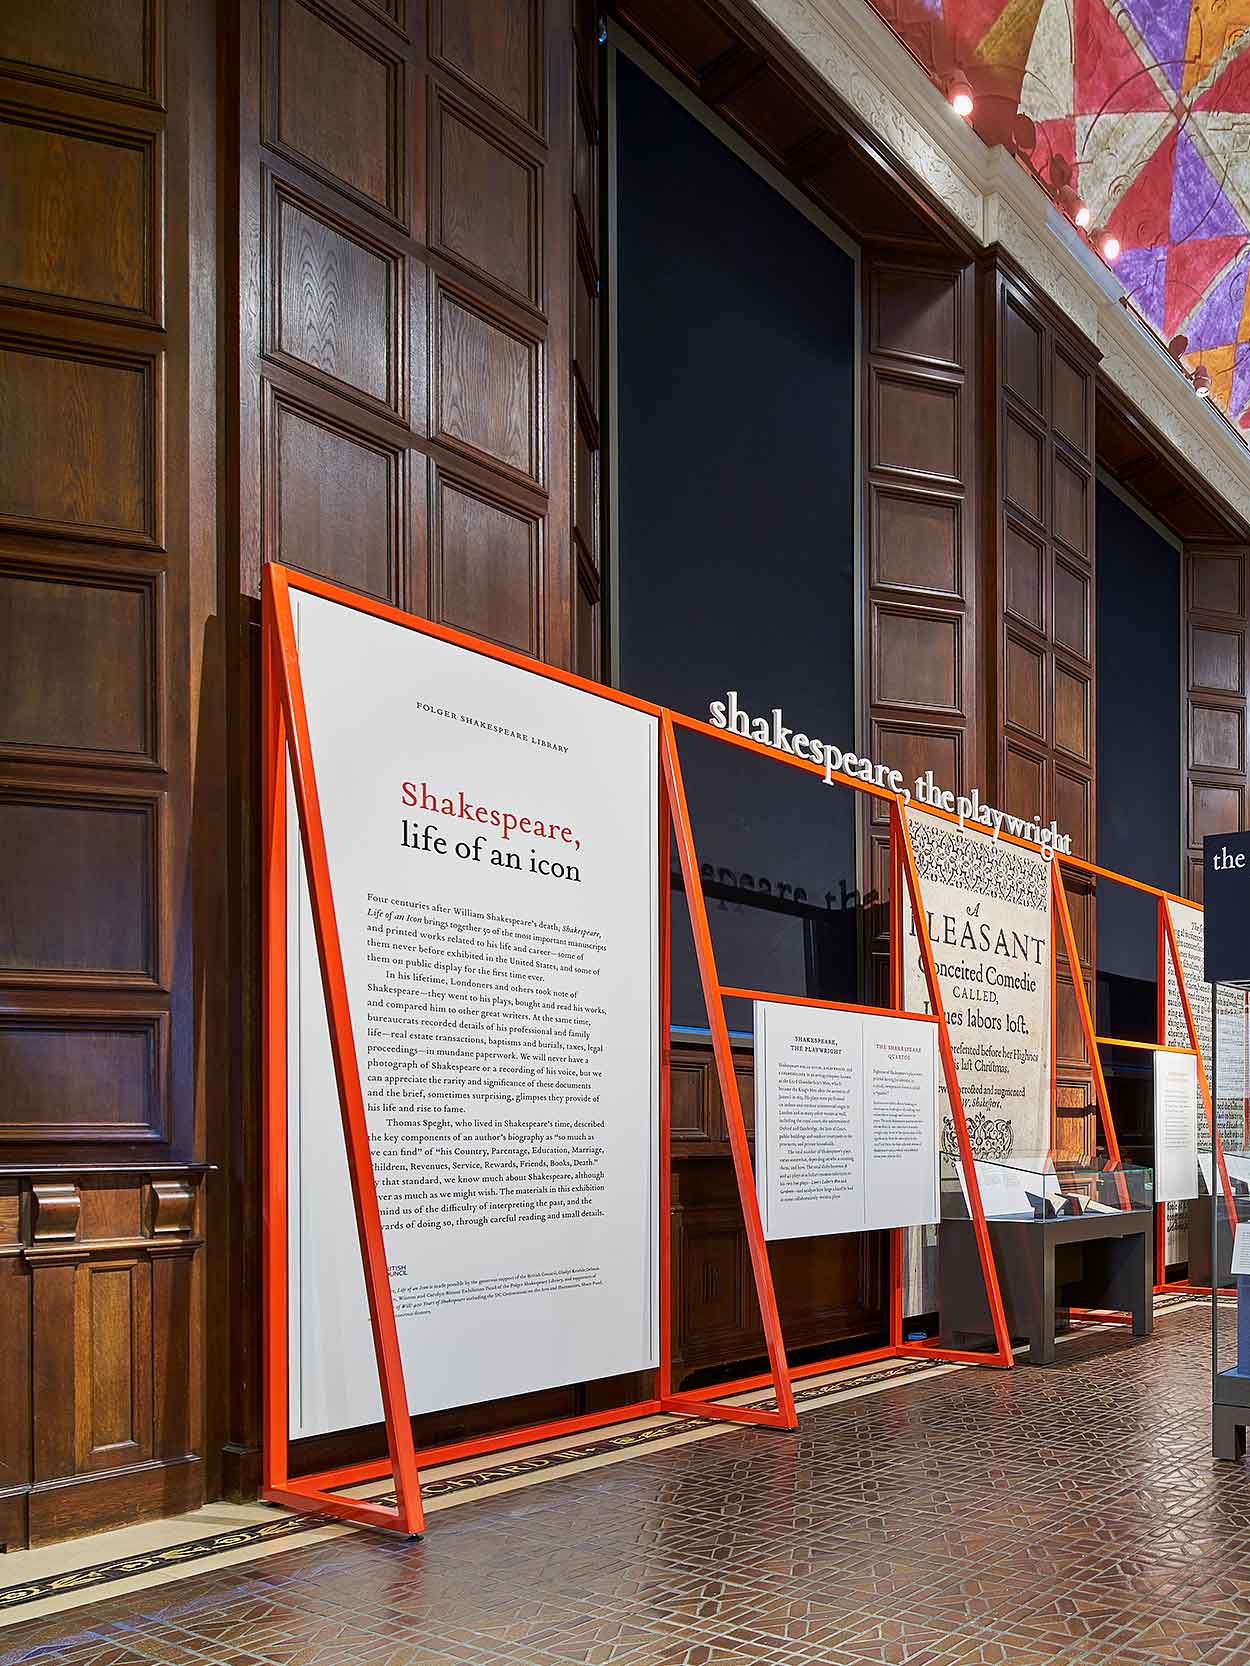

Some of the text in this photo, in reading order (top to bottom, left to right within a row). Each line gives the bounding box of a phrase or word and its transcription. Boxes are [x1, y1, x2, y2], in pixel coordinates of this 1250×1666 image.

[416, 702, 569, 754] FOLGER SHAKESPEARE LIBRARY
[709, 691, 1072, 862] shakespeare, the playwright
[402, 782, 580, 851] Shakespeare,
[401, 820, 581, 882] life of an icon
[1213, 847, 1246, 870] the
[367, 893, 388, 903] Four
[390, 898, 430, 910] centuries
[431, 903, 451, 914] after
[453, 907, 484, 919] William
[967, 902, 980, 917] A
[366, 924, 383, 932] and
[385, 926, 417, 937] printed
[419, 932, 445, 941] works
[447, 935, 475, 945] related
[486, 939, 498, 948] his
[499, 941, 511, 951] life
[367, 908, 383, 919] Life
[384, 911, 392, 921] of
[406, 914, 422, 923] Icon
[423, 916, 448, 930] brings
[450, 922, 482, 933] together
[501, 928, 513, 937] the
[532, 933, 566, 945] important
[567, 941, 606, 952] manuscripts
[367, 937, 390, 948] them
[392, 943, 416, 951] never
[418, 944, 444, 955] before
[446, 949, 484, 960] exhibited
[485, 953, 494, 962] in
[495, 955, 508, 964] the
[509, 957, 534, 967] United
[367, 952, 390, 963] them
[405, 958, 431, 968] public
[433, 960, 462, 974] display
[464, 965, 476, 973] for
[478, 966, 490, 975] the
[492, 967, 508, 977] first
[509, 970, 526, 979] time
[385, 970, 395, 979] In
[398, 971, 410, 980] his
[450, 977, 493, 989] Londoners
[494, 983, 509, 991] and
[510, 984, 534, 993] others
[535, 988, 551, 996] took
[986, 966, 1036, 992] Comedie
[479, 994, 490, 1003] his
[514, 997, 540, 1010] bought
[572, 1003, 583, 1012] his
[953, 986, 999, 1005] CALLED,
[367, 999, 383, 1007] and
[385, 1002, 427, 1013] compared
[429, 1003, 446, 1013] him
[457, 1006, 479, 1015] other
[480, 1010, 500, 1019] great
[542, 1014, 553, 1022] the
[967, 1008, 1002, 1030] labors
[367, 1012, 419, 1025] bureaucrats
[421, 1016, 457, 1028] recorded
[458, 1020, 484, 1030] details
[485, 1022, 495, 1030] of
[496, 1023, 507, 1032] his
[508, 1025, 552, 1035] professional
[568, 1028, 590, 1040] family
[436, 1048, 474, 1057] mundane
[532, 1053, 546, 1061] will
[568, 1055, 584, 1063] have
[488, 1036, 521, 1048] baptisms
[522, 1039, 536, 1047] and
[587, 1043, 603, 1054] legal
